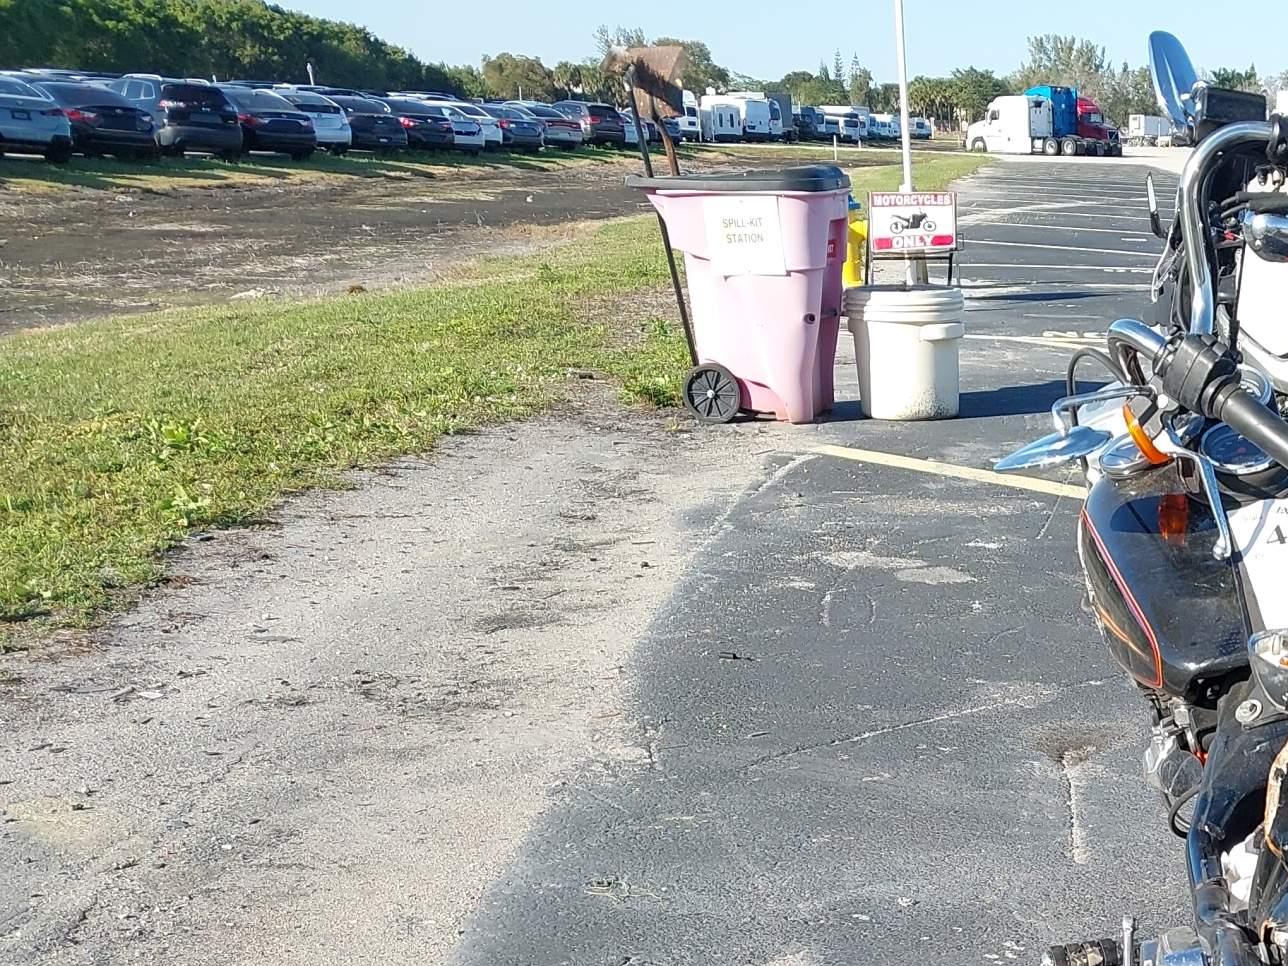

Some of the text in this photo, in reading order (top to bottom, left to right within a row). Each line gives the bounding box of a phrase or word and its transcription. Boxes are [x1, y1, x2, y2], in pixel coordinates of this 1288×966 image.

[872, 193, 953, 207] MOTORCYCLES
[722, 216, 763, 229] SPILL-KIT
[726, 232, 765, 244] STATION
[891, 234, 934, 249] ONLY
